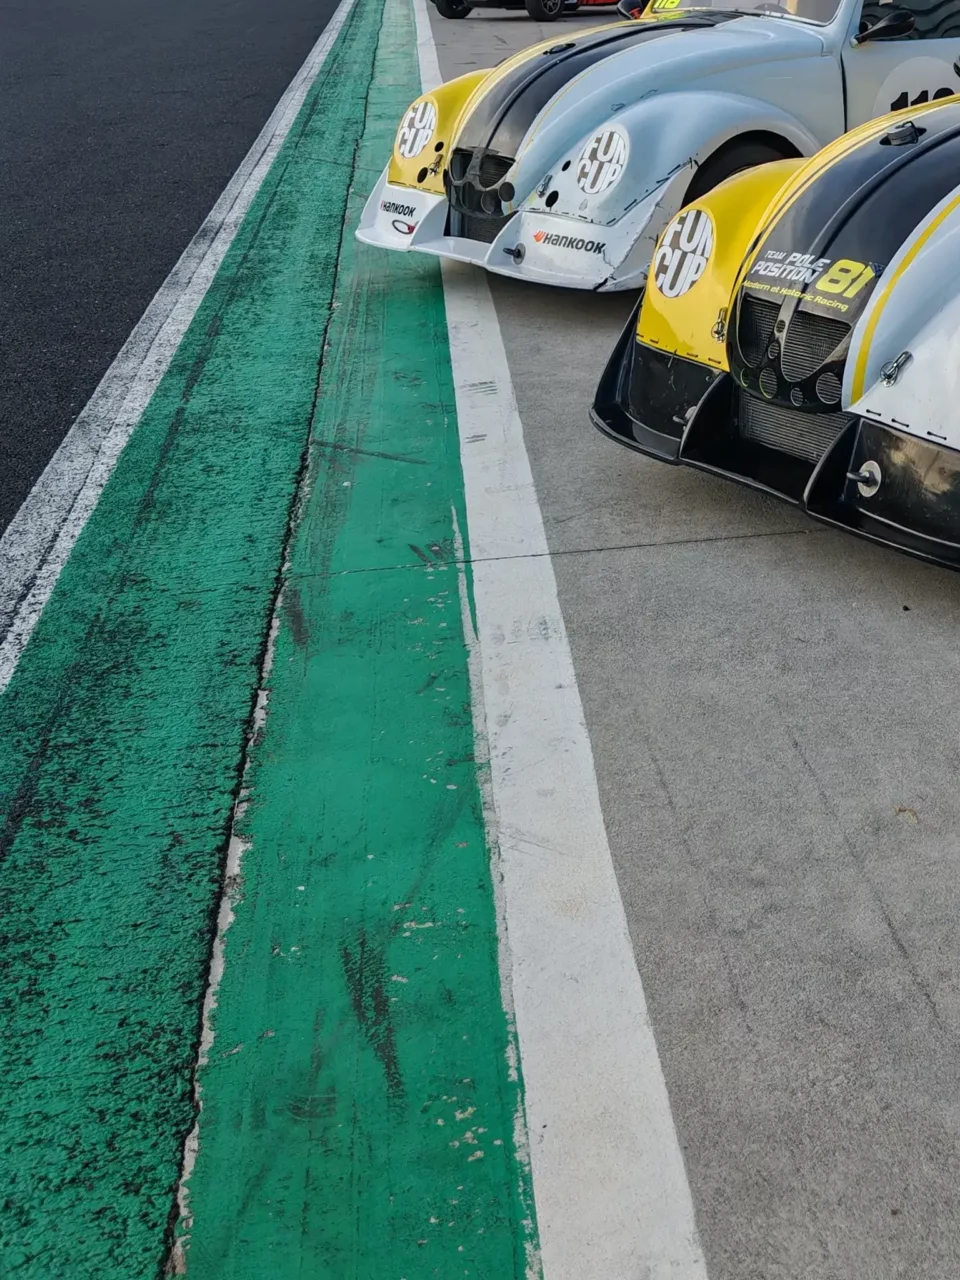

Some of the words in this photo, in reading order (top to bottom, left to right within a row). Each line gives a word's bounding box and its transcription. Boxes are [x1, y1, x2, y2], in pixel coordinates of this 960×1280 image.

[402, 101, 436, 130] FUN
[398, 127, 433, 158] CUP
[582, 131, 626, 165] FUN
[577, 158, 622, 195] CUP
[661, 209, 713, 258] FUN
[655, 245, 708, 298] CUP
[751, 261, 820, 284] POSITION
[764, 250, 788, 260] TEAM
[784, 252, 831, 272] POLE
[815, 259, 876, 298] 81
[813, 294, 849, 313] Racing
